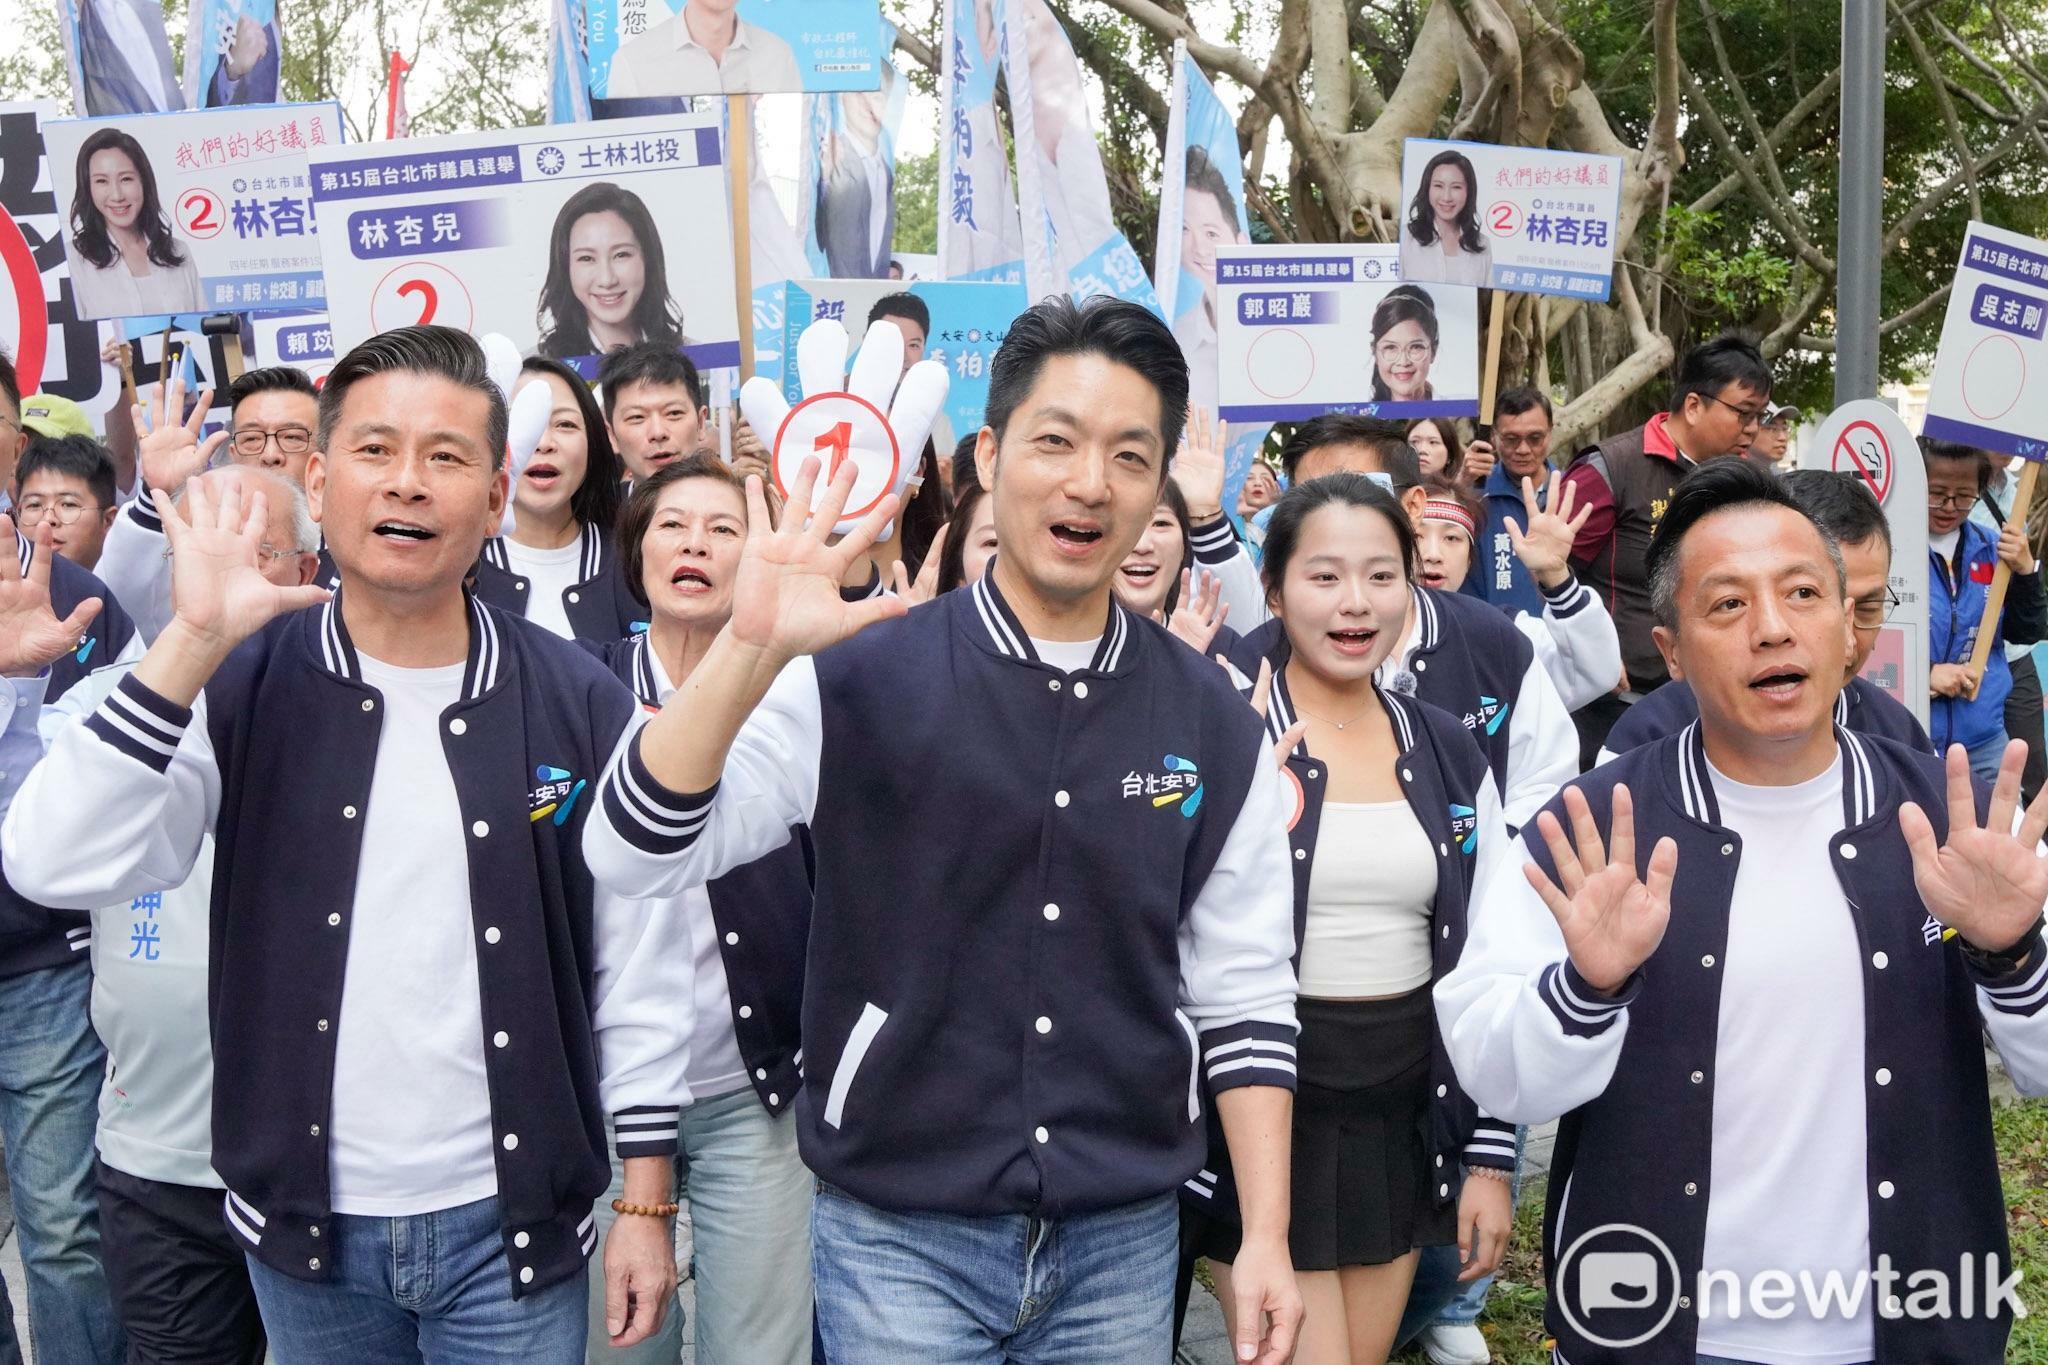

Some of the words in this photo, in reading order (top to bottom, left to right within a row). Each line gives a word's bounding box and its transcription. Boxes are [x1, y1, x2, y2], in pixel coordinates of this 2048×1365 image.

[593, 9, 607, 42] You
[622, 0, 647, 35] 您
[176, 116, 327, 169] 我們的好議員
[579, 138, 681, 169] 士林北投
[251, 175, 314, 191] 台北市議
[320, 155, 515, 191] 第15屆台北市議員選舉
[1495, 164, 1609, 188] 我們的好議員
[184, 195, 218, 231] 2
[1492, 206, 1513, 230] 2
[1526, 213, 1608, 248] 林杏兒
[358, 212, 461, 250] 林杏兒
[1222, 263, 1350, 278] 第15屆台北市議員選舉
[1979, 294, 2043, 332] 吳志剛
[941, 330, 965, 342] 大安
[814, 421, 852, 487] 1
[1494, 533, 1513, 590] 黃水原
[1121, 770, 1198, 798] 台北安可
